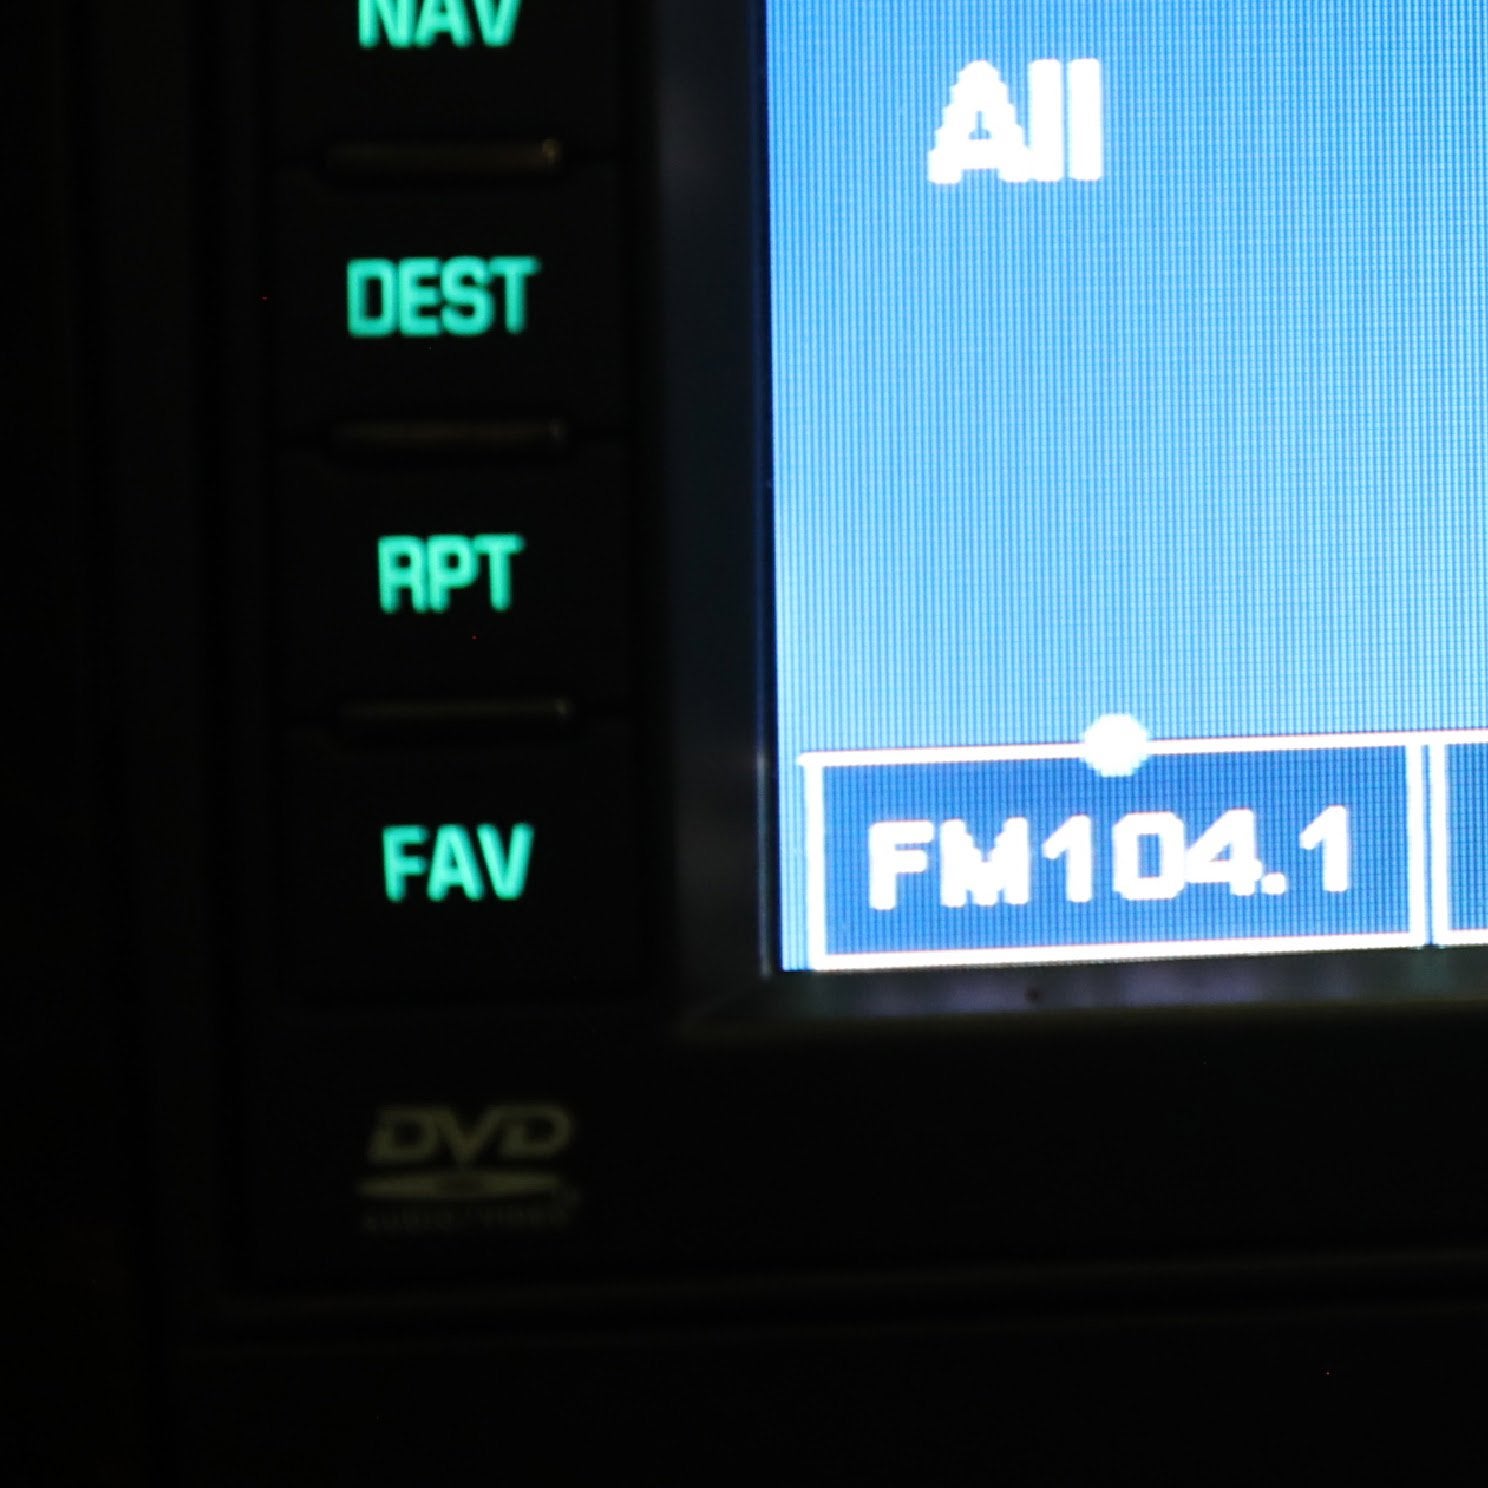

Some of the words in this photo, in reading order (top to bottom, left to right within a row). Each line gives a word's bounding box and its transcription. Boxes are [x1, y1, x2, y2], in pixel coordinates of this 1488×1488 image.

[929, 58, 1103, 185] All
[347, 256, 536, 336] DEST
[378, 534, 522, 611] RPT
[383, 824, 533, 900] FAV
[870, 806, 1349, 909] FM104.1
[366, 1102, 578, 1168] DVD
